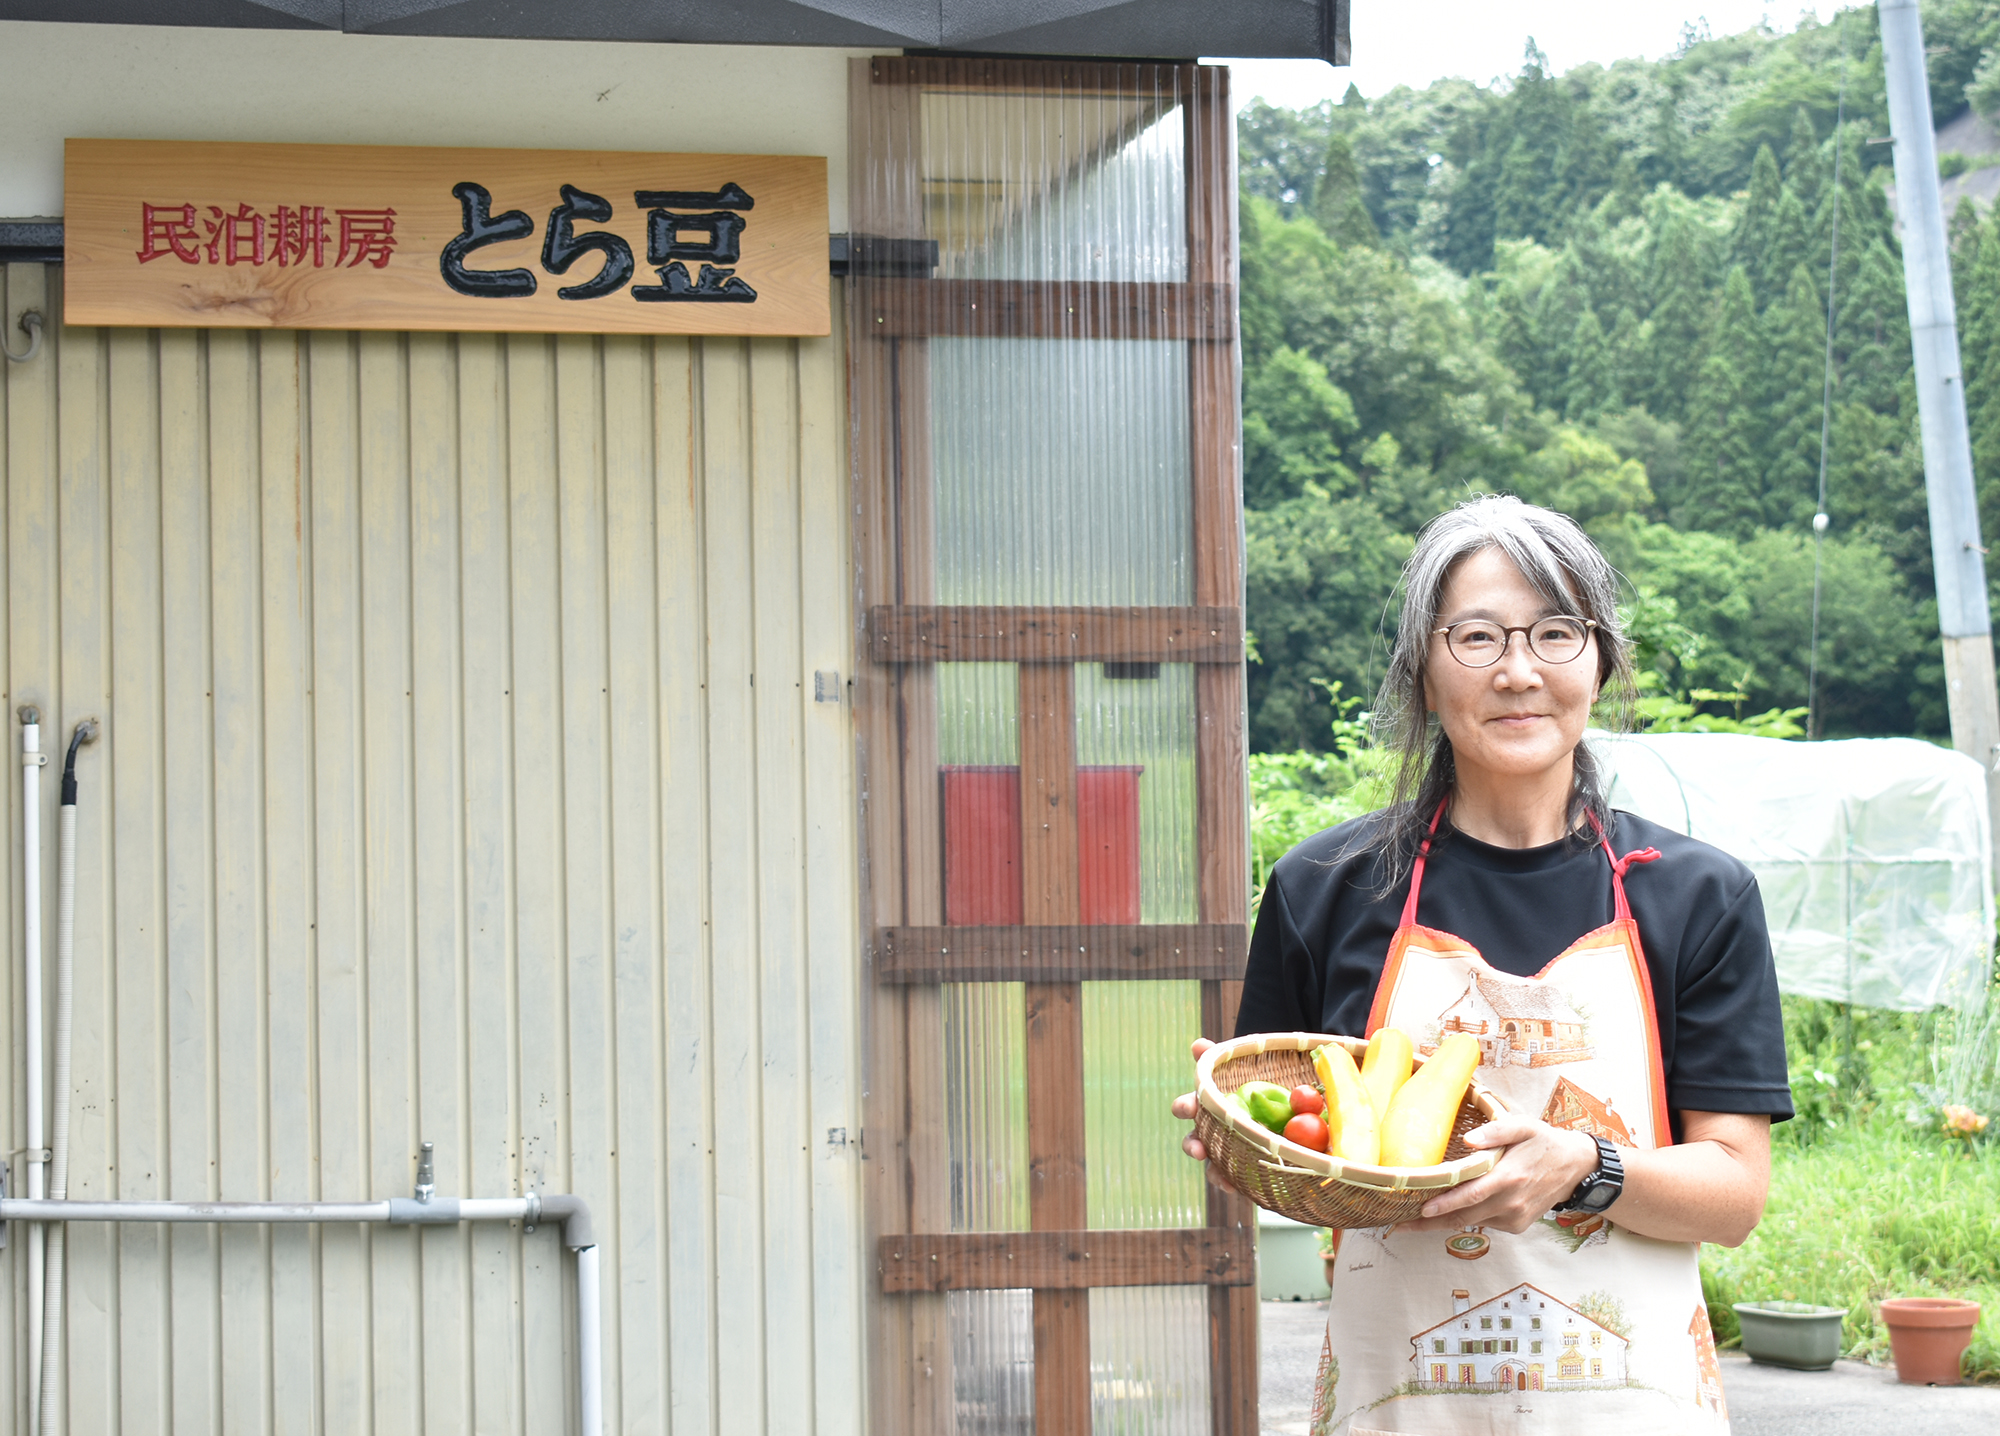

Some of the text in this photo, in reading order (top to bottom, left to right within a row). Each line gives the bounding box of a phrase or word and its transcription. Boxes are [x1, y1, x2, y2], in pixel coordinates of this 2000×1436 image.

[138, 182, 757, 303] 民泊耕房 とら豆
